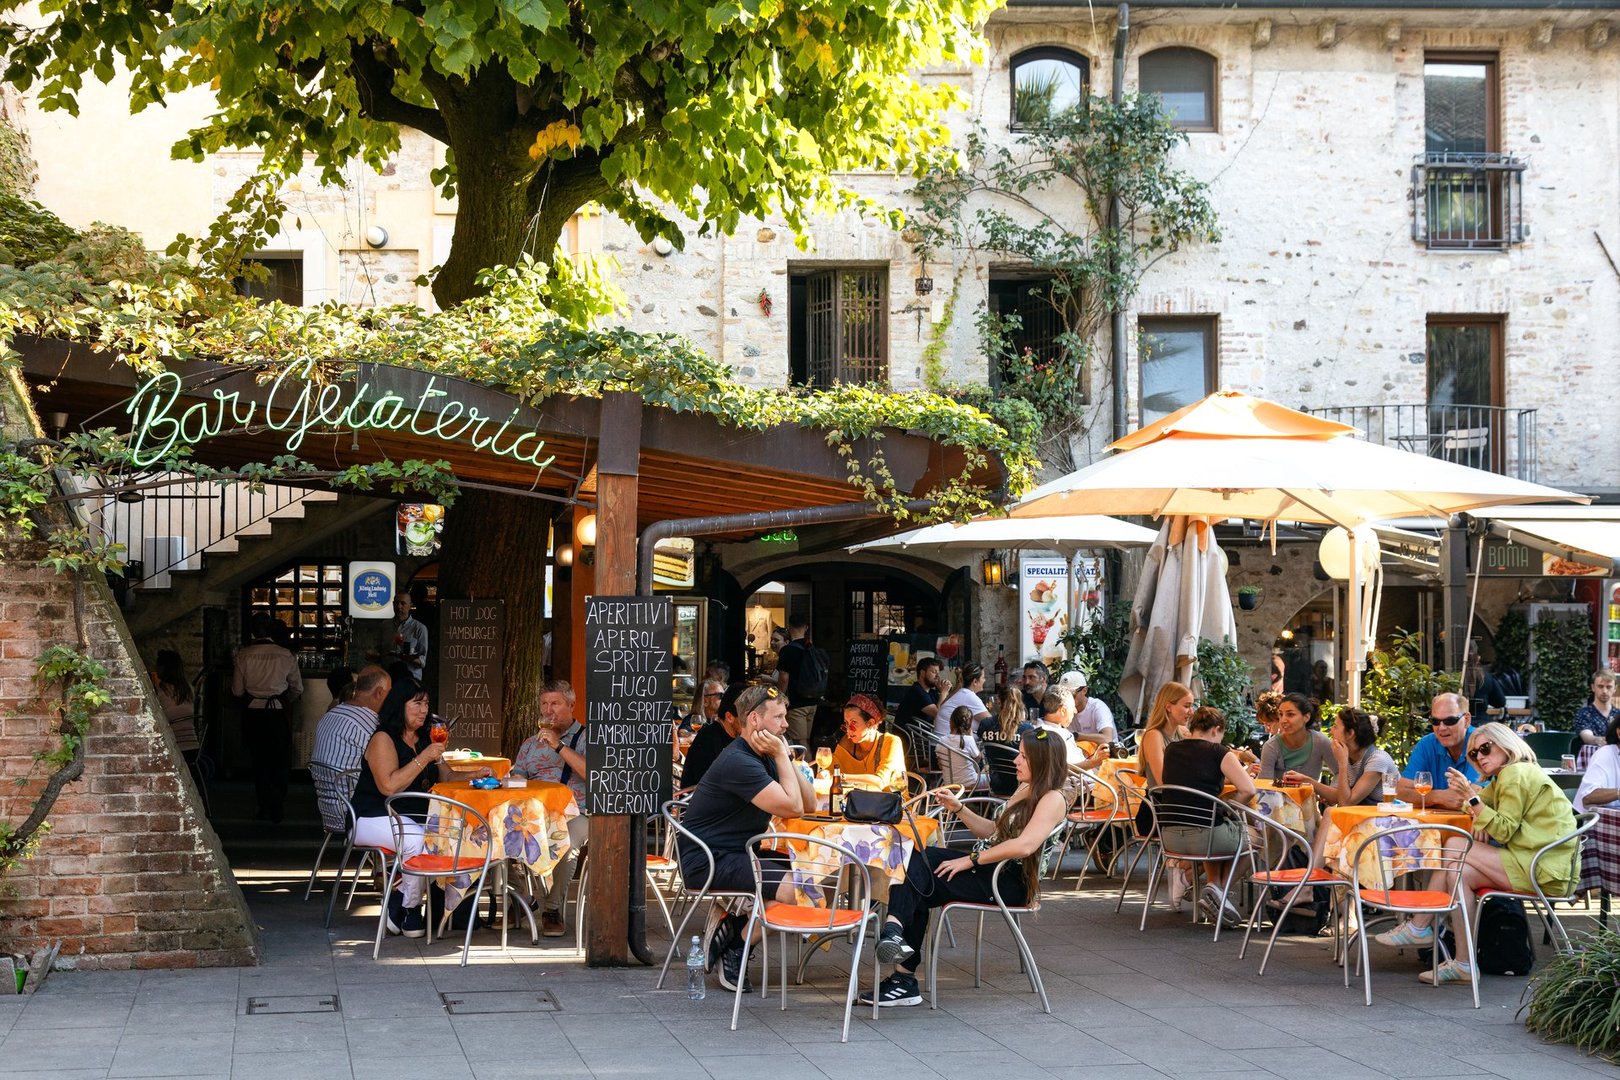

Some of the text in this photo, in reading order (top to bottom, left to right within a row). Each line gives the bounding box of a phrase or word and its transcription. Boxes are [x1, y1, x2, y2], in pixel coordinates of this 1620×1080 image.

[126, 356, 556, 467] Bar Gelateria
[450, 606, 497, 621] HOT DOG
[585, 601, 668, 625] APERITIVI
[593, 629, 660, 649] APEROL
[593, 650, 669, 672] SPRITZ
[850, 656, 876, 666] APEROL
[453, 664, 488, 679] TOAST
[848, 668, 880, 679] SPRITZ
[455, 683, 490, 699] PIZZA
[611, 675, 657, 697] HUGO
[445, 702, 493, 719] PIADINA
[626, 701, 673, 721] SPRITZ
[448, 722, 500, 739] RUSCHETTE
[982, 730, 1007, 741] 4810
[602, 746, 657, 769] BERTO
[589, 770, 661, 793] PROSECCO
[593, 793, 659, 814] NEGRONI
